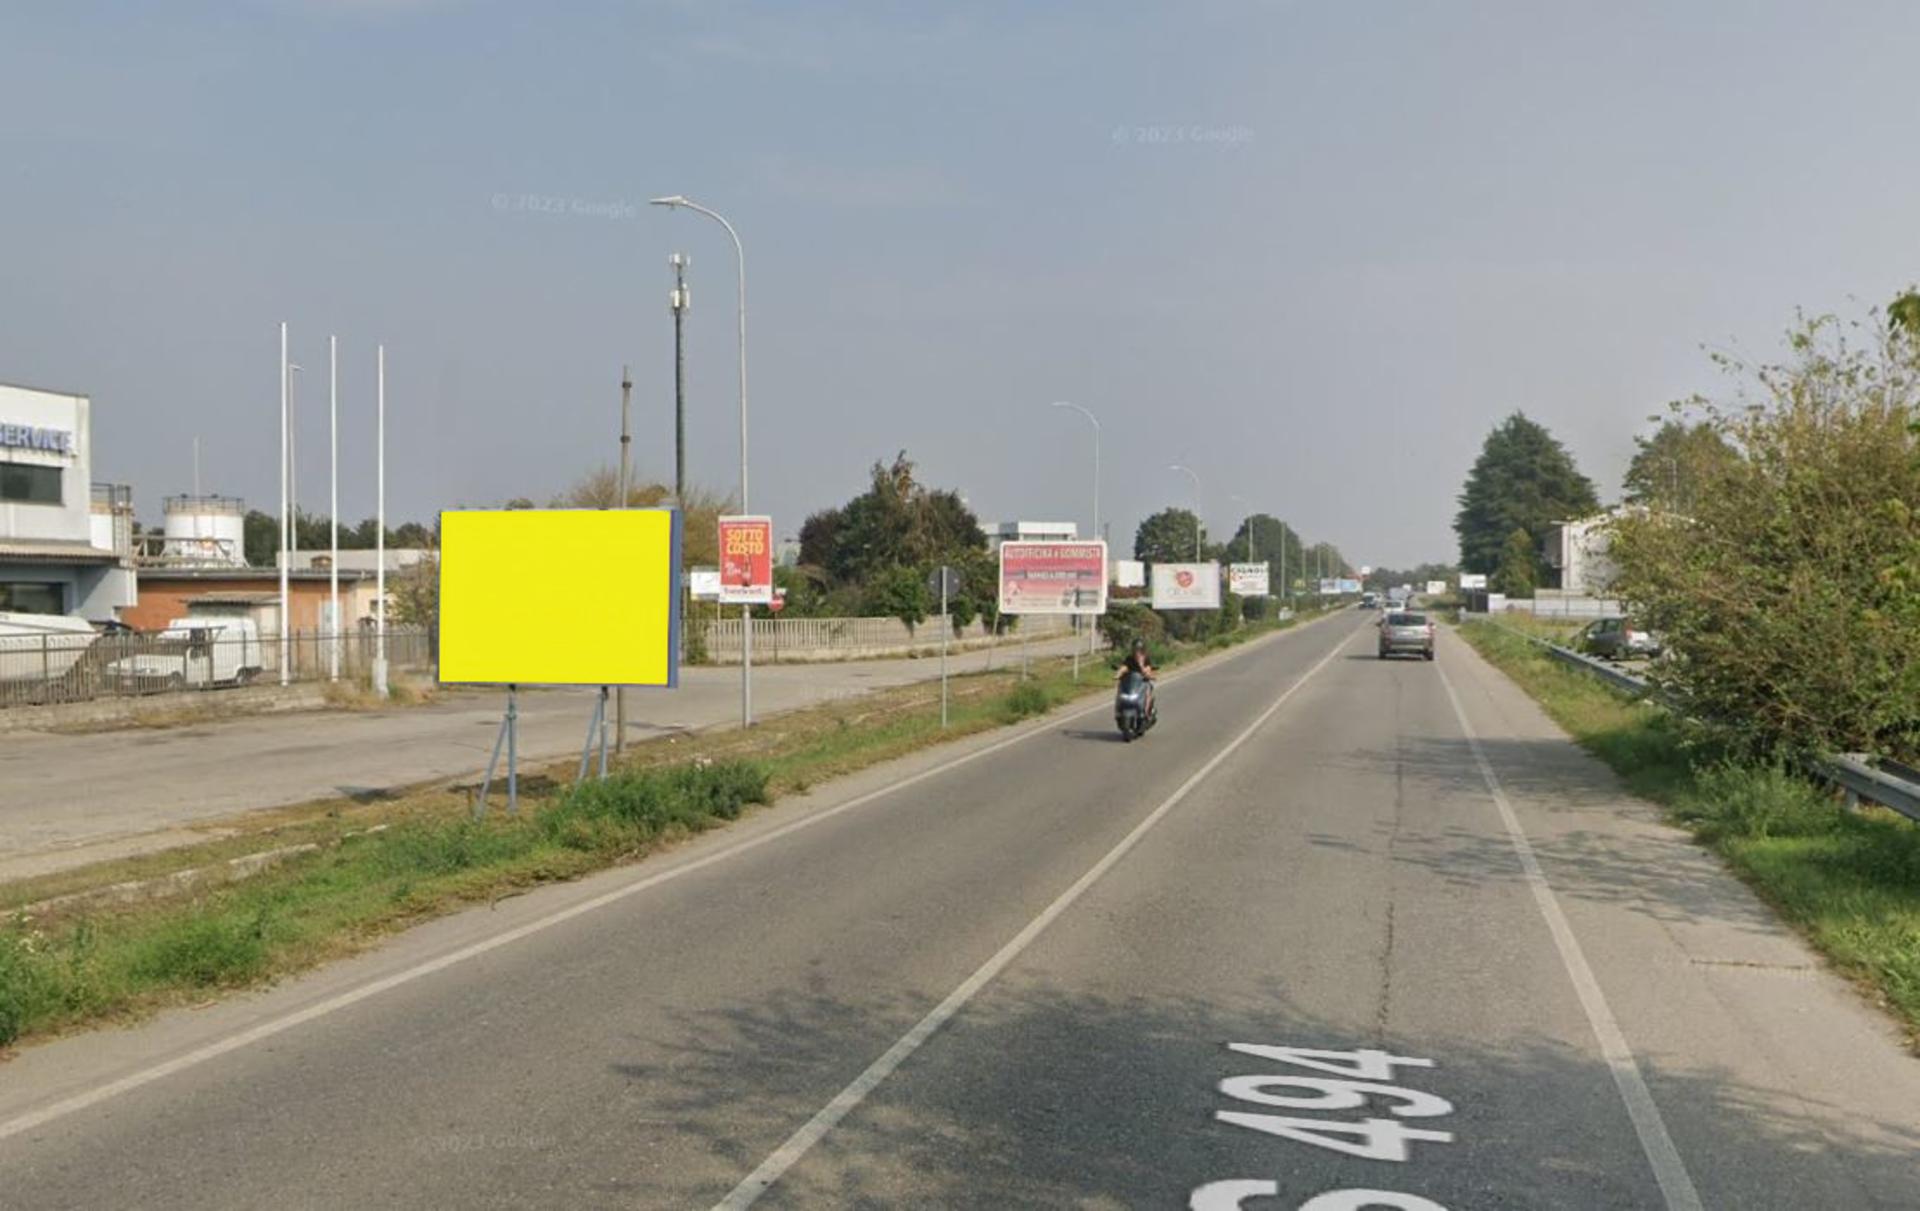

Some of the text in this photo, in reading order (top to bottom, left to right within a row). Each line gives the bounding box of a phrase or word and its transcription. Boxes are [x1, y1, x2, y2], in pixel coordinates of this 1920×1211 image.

[727, 528, 764, 542] SOTTO
[727, 542, 764, 555] COSTO
[1215, 1042, 1454, 1162] 494
